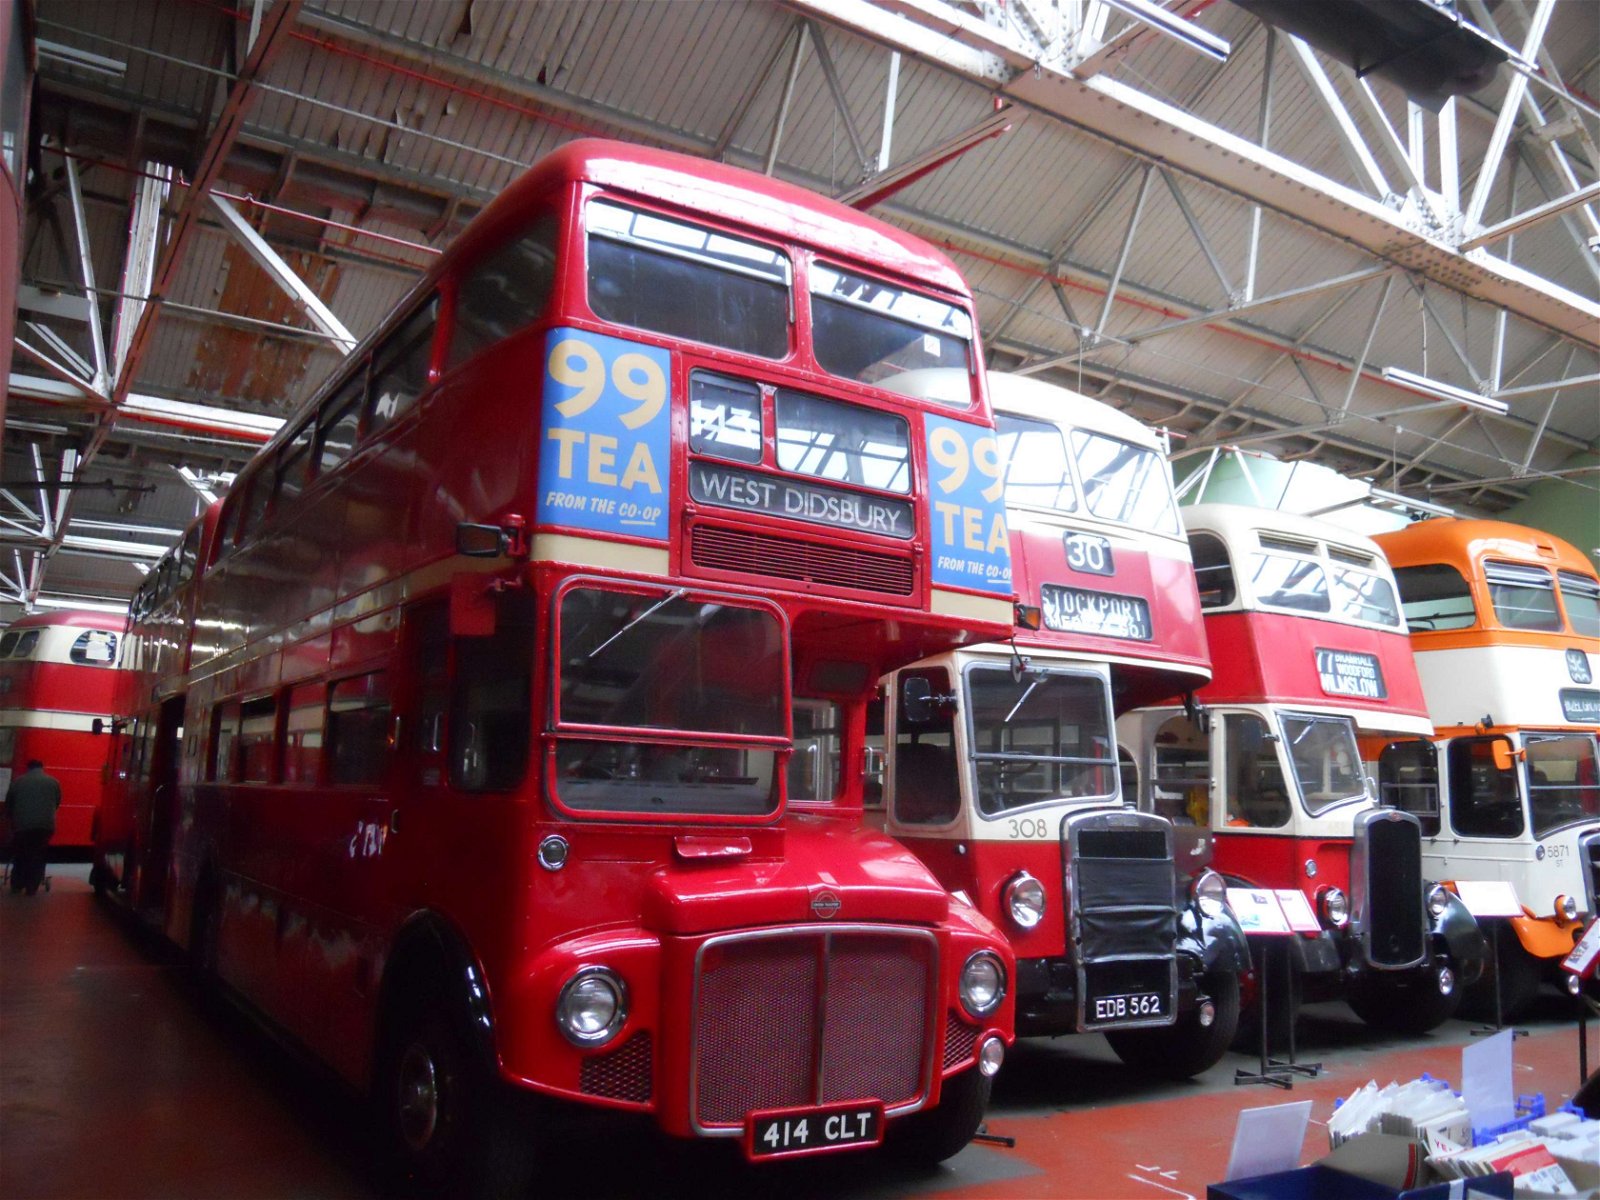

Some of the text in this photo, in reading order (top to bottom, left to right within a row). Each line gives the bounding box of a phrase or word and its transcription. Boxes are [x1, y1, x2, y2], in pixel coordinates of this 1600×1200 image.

[548, 339, 667, 430] 99
[548, 428, 662, 494] TEA
[930, 427, 1005, 504] 99
[545, 491, 586, 511] FROM
[591, 497, 616, 515] THE
[701, 471, 901, 532] WEST DIDSBURY
[935, 501, 1011, 558] TEA
[937, 556, 964, 573] FROM
[967, 561, 984, 576] THE
[1066, 533, 1105, 570] 30
[1042, 588, 1141, 622] STOCKPORT
[1320, 673, 1378, 698] WILMSLOW
[1336, 663, 1376, 679] WOODFORD
[1008, 819, 1048, 839] 308
[1547, 845, 1570, 858] 5871
[1096, 996, 1160, 1018] EDB 562
[764, 1112, 871, 1147] 414 CLT
